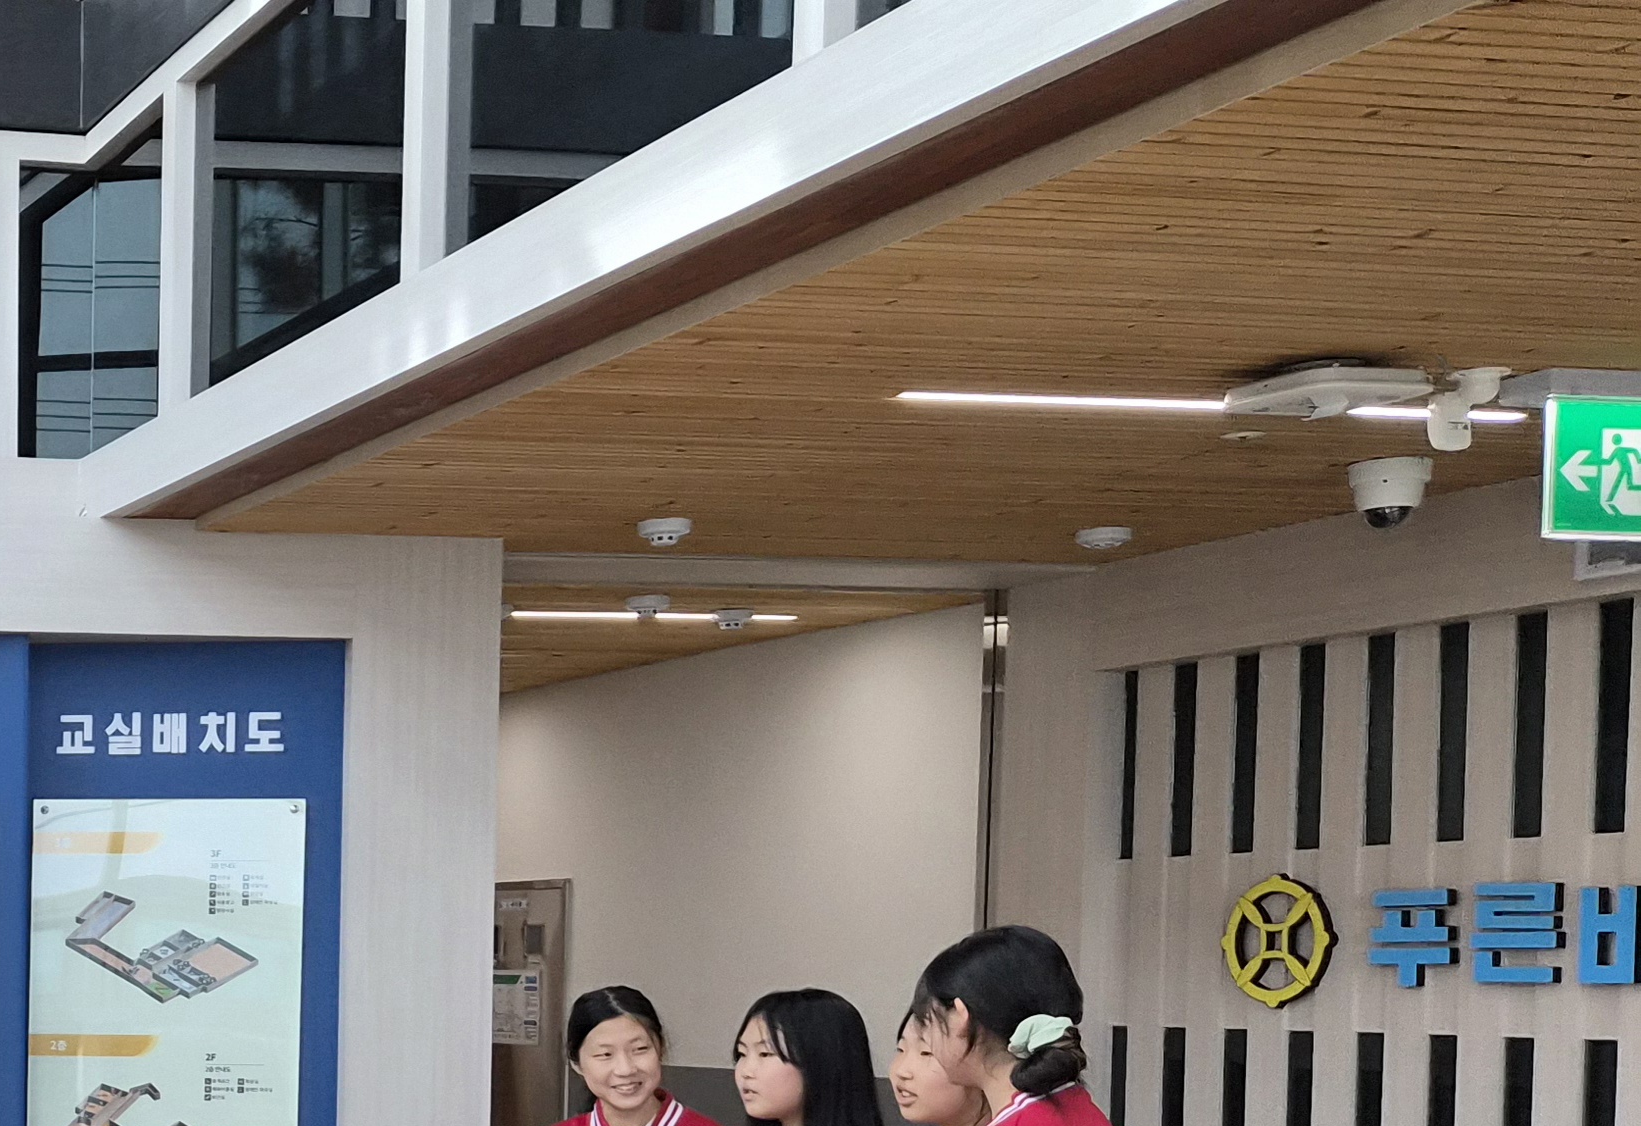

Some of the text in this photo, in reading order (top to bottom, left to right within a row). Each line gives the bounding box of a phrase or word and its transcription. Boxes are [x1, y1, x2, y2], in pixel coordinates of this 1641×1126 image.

[56, 711, 284, 755] 교실배치도
[50, 1040, 67, 1051] 2층
[205, 1053, 217, 1061] 2F
